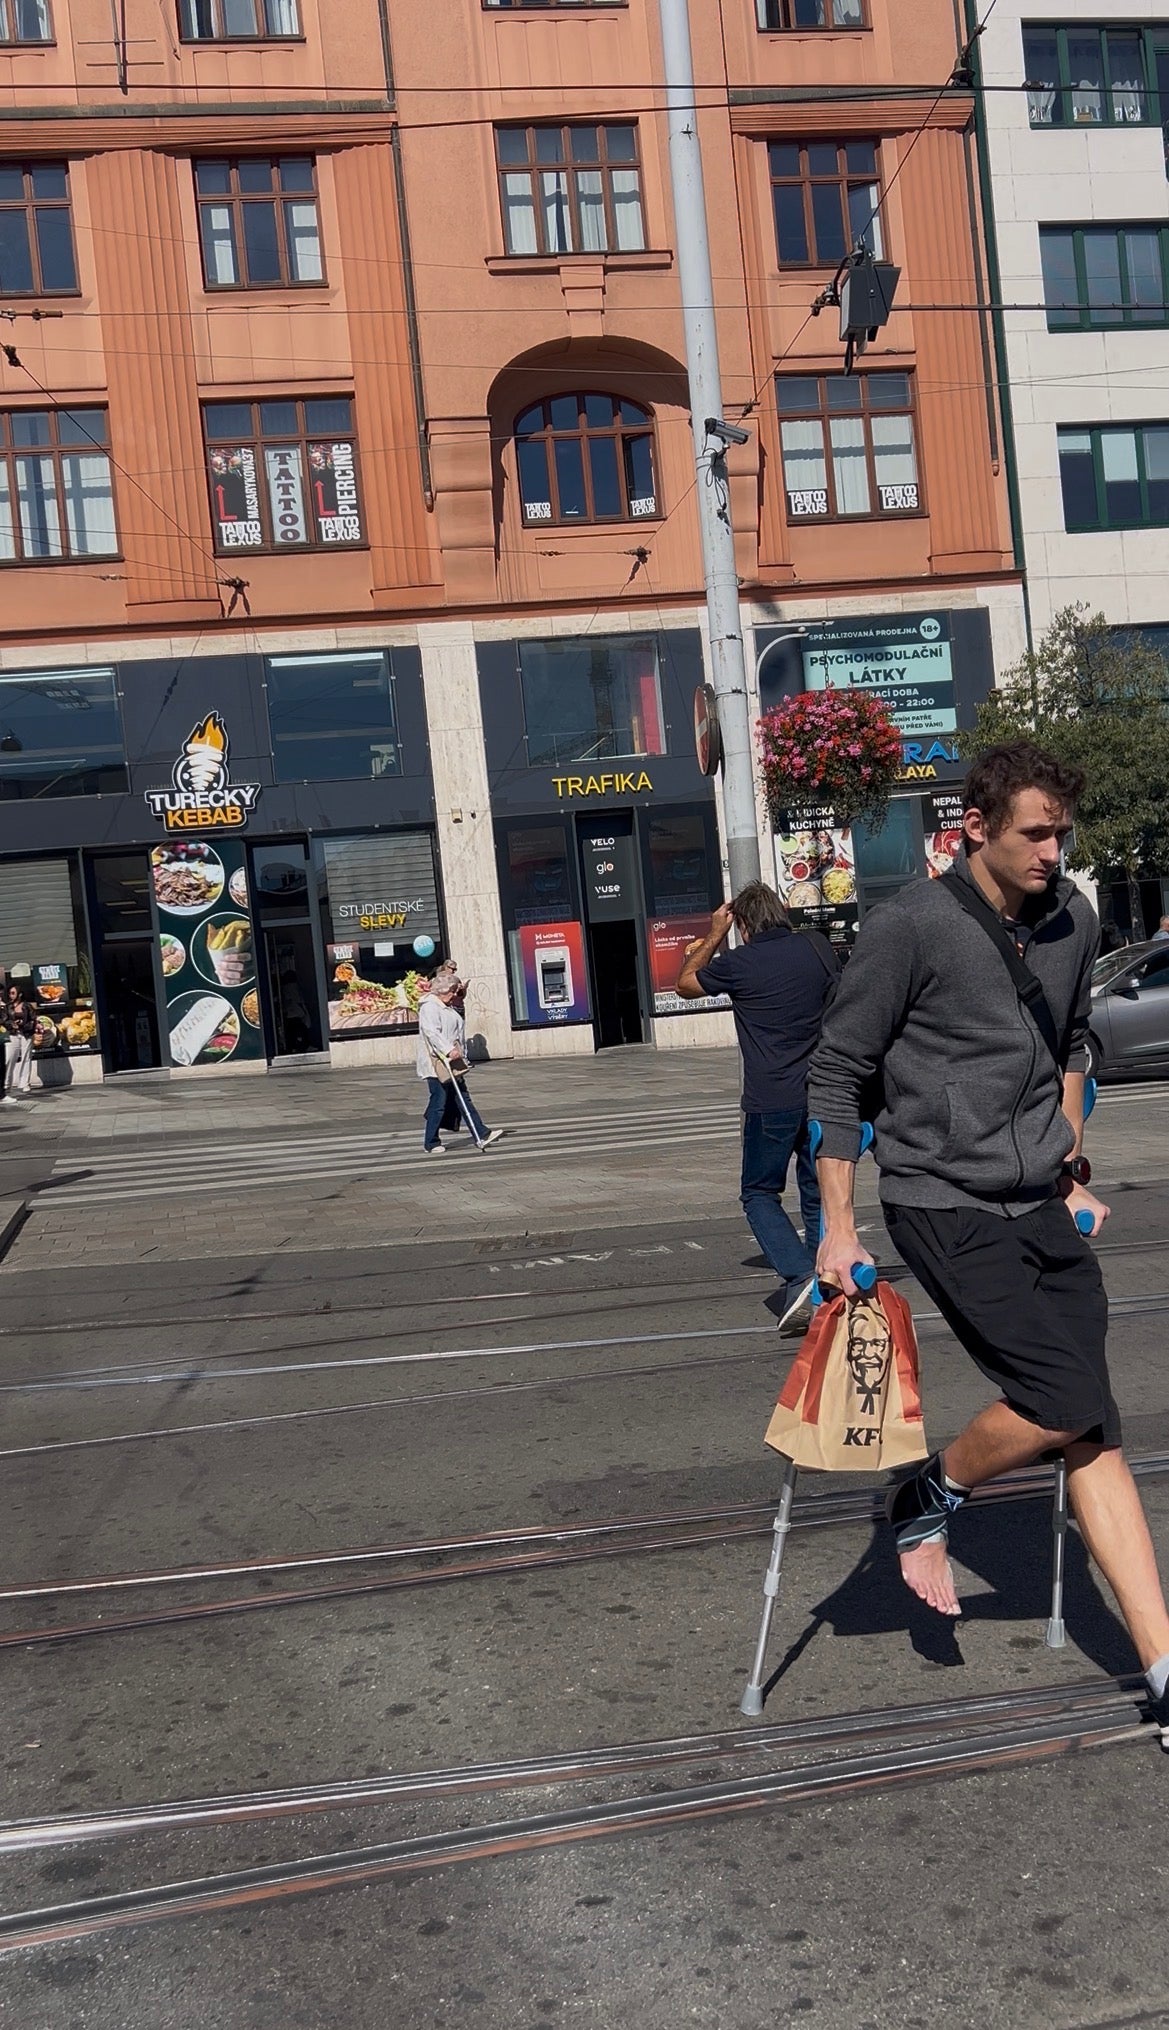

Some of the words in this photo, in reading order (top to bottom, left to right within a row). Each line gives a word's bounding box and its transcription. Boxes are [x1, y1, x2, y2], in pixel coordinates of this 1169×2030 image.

[332, 443, 358, 515] PIERCING
[273, 452, 300, 541] TATTOO
[788, 490, 826, 503] TATTOO
[879, 485, 917, 498] TATTOO
[792, 502, 828, 515] LEXUS
[883, 496, 918, 509] LEXUS
[527, 509, 551, 519] LEXUS
[632, 505, 656, 516] LEXUS
[219, 521, 261, 536] TATTOO
[318, 516, 360, 531] TATTOO
[223, 533, 262, 546] LEXUS
[322, 528, 361, 542] LEXUS
[808, 629, 875, 641] SPECIALIZOVANÁ
[875, 627, 918, 637] PRODEJNA
[922, 624, 939, 633] 18+
[809, 645, 943, 667] PSYCHOMODULAČNÍ
[849, 667, 907, 684] LÁTKY
[893, 688, 919, 697] DOBA
[906, 698, 935, 707] 22:00
[895, 765, 937, 780] LAYA
[551, 771, 653, 797] TRAFIKA
[149, 785, 255, 811] TURECKÝ
[932, 796, 963, 807] NEPAL
[167, 806, 243, 827] KEBAB
[938, 809, 945, 818] &
[946, 808, 963, 817] IND
[789, 816, 835, 830] KUCHYNĚ
[940, 819, 963, 829] CUIS
[590, 837, 615, 846] VELO
[596, 861, 614, 875] glo
[339, 898, 425, 918] STUDENTSKÉ
[360, 914, 406, 928] SLEVY
[653, 921, 667, 932] glo
